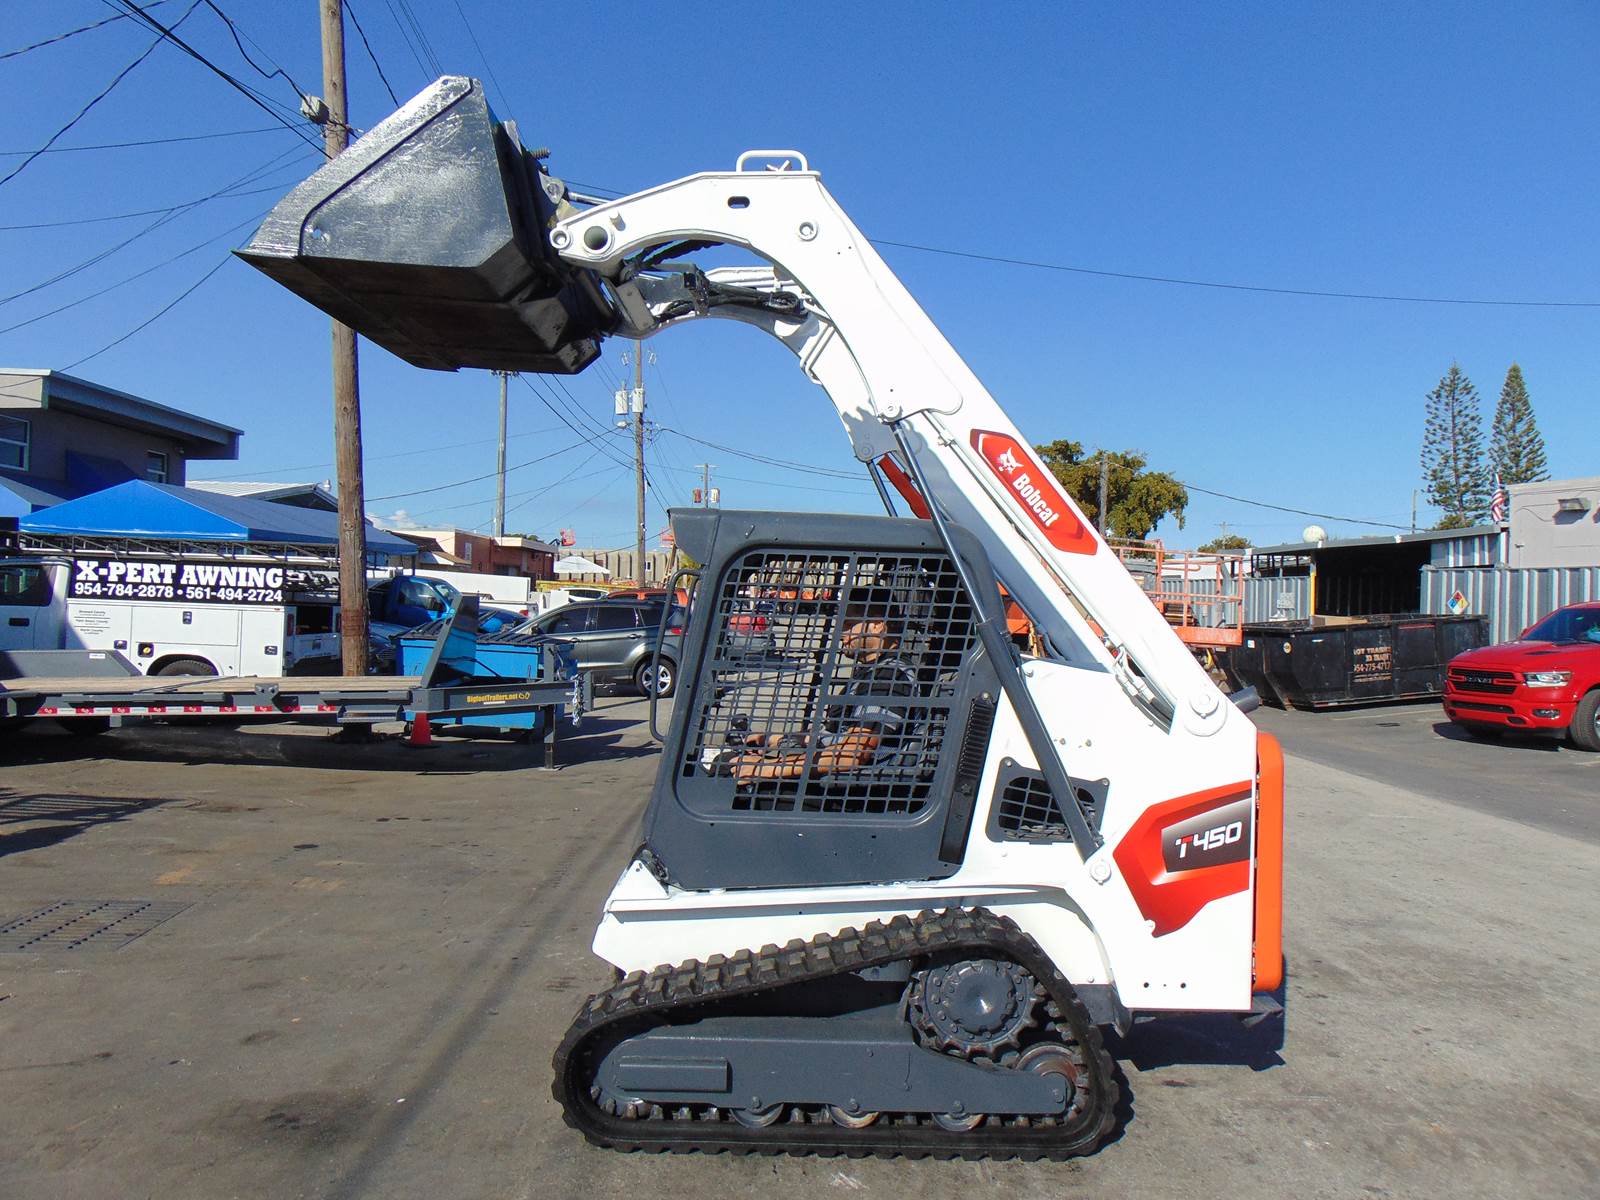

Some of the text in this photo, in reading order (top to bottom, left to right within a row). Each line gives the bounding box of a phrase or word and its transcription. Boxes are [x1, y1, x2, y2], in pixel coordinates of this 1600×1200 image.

[1012, 473, 1060, 527] Bobcat
[75, 560, 283, 589] X-PERT AWNING
[75, 583, 283, 602] 954-784-2878 561-494-2724
[1175, 821, 1243, 859] T450
